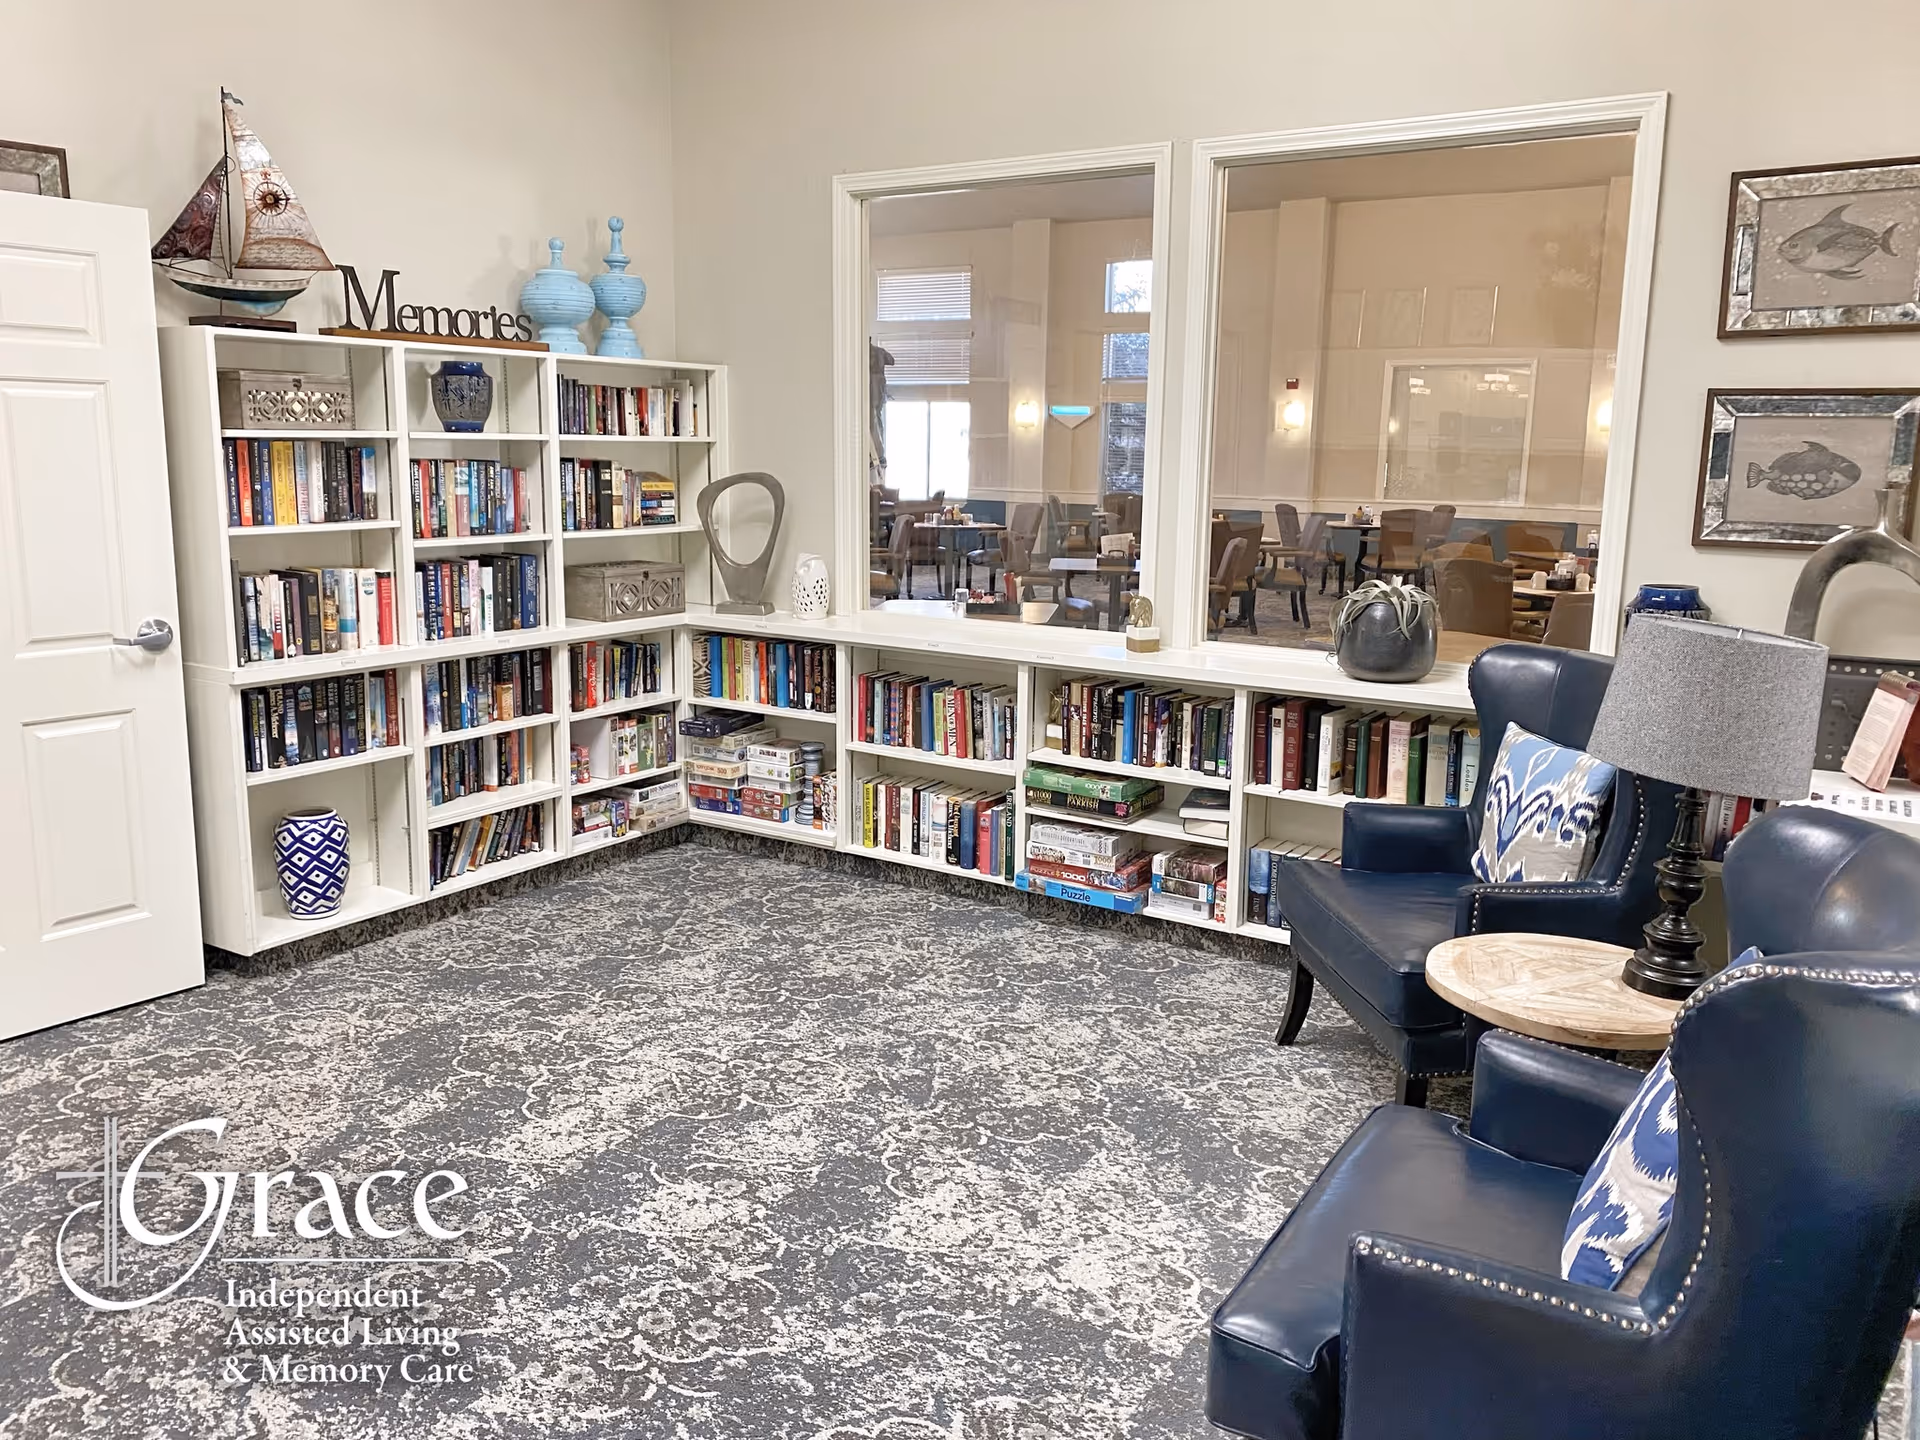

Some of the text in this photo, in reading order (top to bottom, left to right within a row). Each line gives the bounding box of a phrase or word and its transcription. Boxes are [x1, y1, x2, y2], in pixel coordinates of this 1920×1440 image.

[335, 265, 533, 342] Memories
[427, 581, 438, 631] KEN FOLLETT
[286, 698, 296, 728] COLUMBUS
[947, 698, 955, 718] MEN
[948, 726, 957, 747] MEN
[1084, 782, 1100, 790] 1000
[1464, 764, 1475, 792] London
[1067, 798, 1099, 809] PARRISH
[1093, 855, 1112, 866] 1000
[1060, 871, 1086, 882] 1000
[1270, 862, 1278, 879] COME
[1270, 878, 1278, 894] UNTO
[1060, 887, 1091, 903] Puzzle
[1270, 894, 1276, 902] ME
[1252, 897, 1260, 913] LUND
